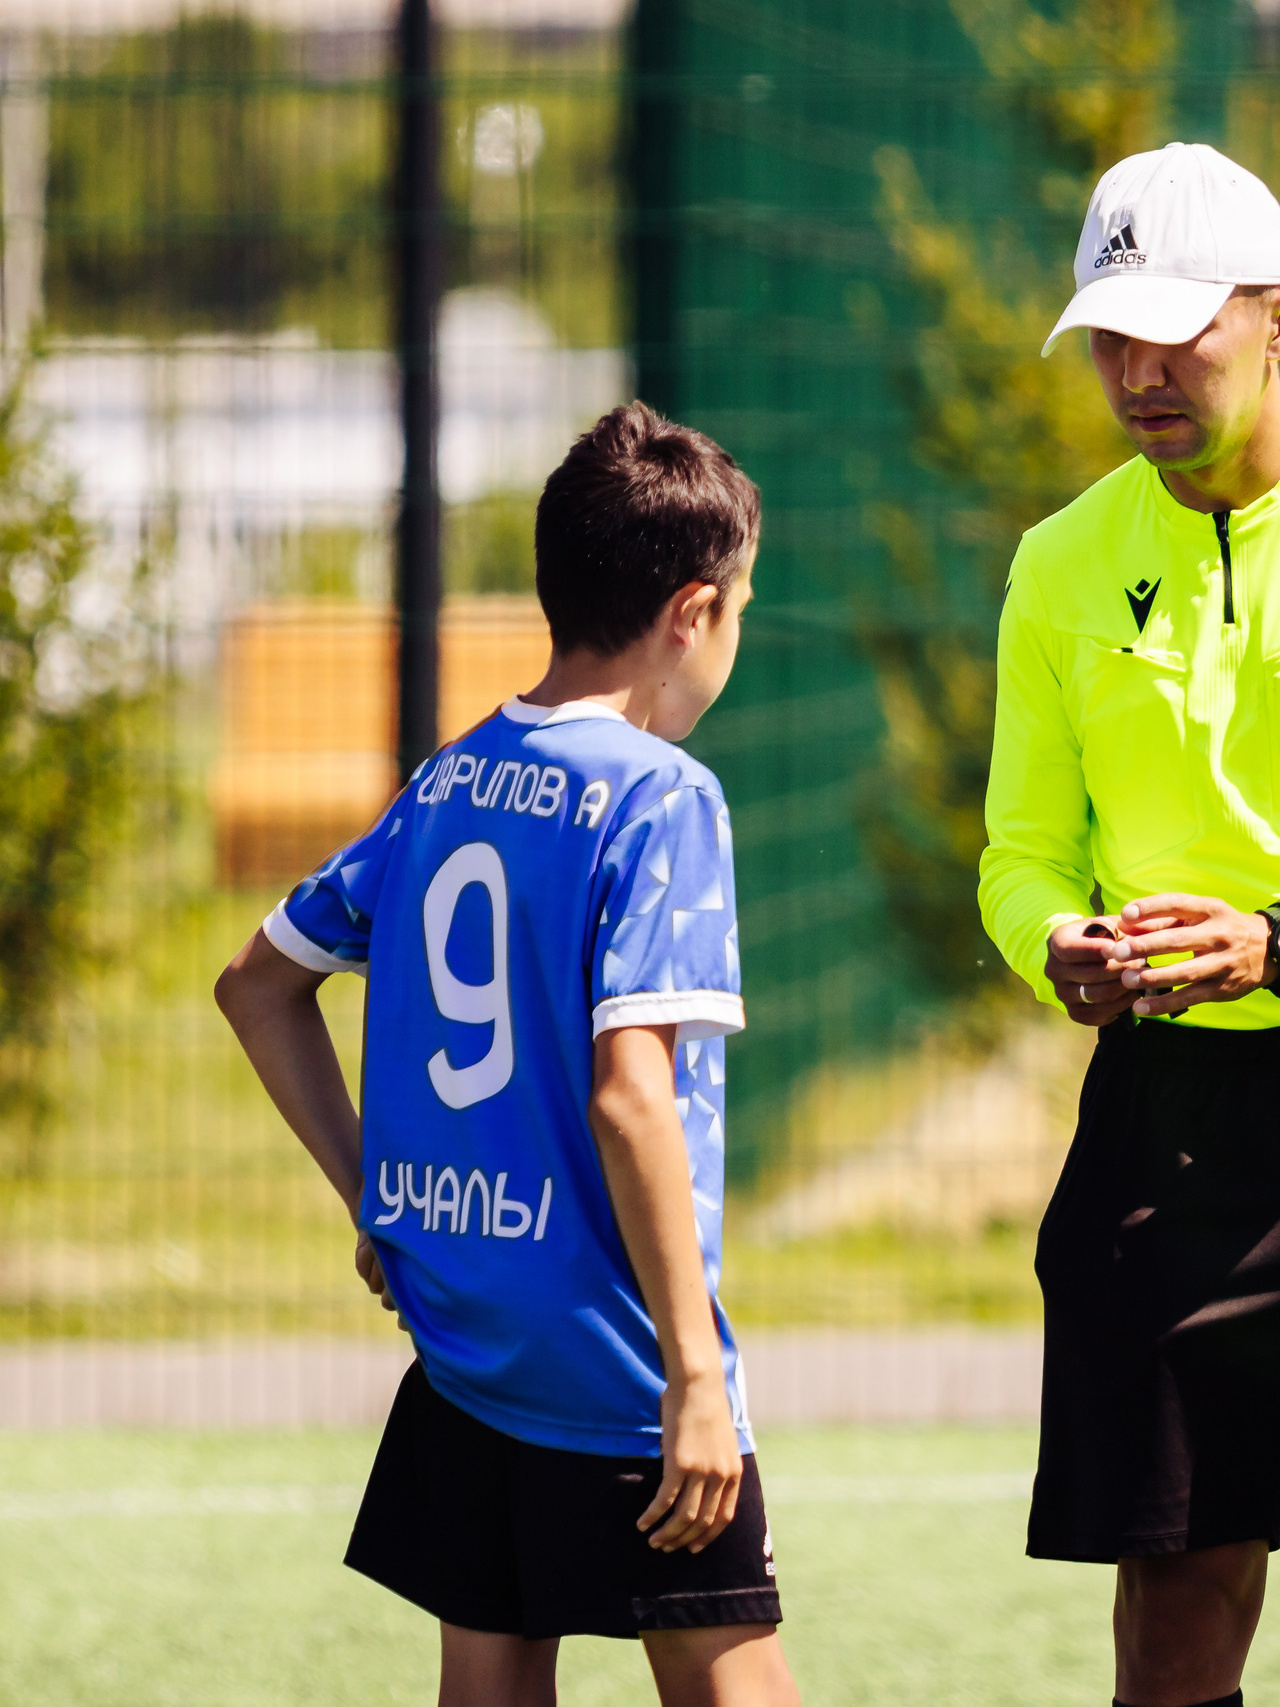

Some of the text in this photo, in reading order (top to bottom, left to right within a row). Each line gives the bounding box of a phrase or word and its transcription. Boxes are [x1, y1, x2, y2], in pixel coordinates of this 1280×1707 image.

[1094, 249, 1146, 269] adidas
[574, 779, 610, 829] А
[423, 841, 513, 1110] 9
[375, 1161, 553, 1242] УЧАЛЫ
